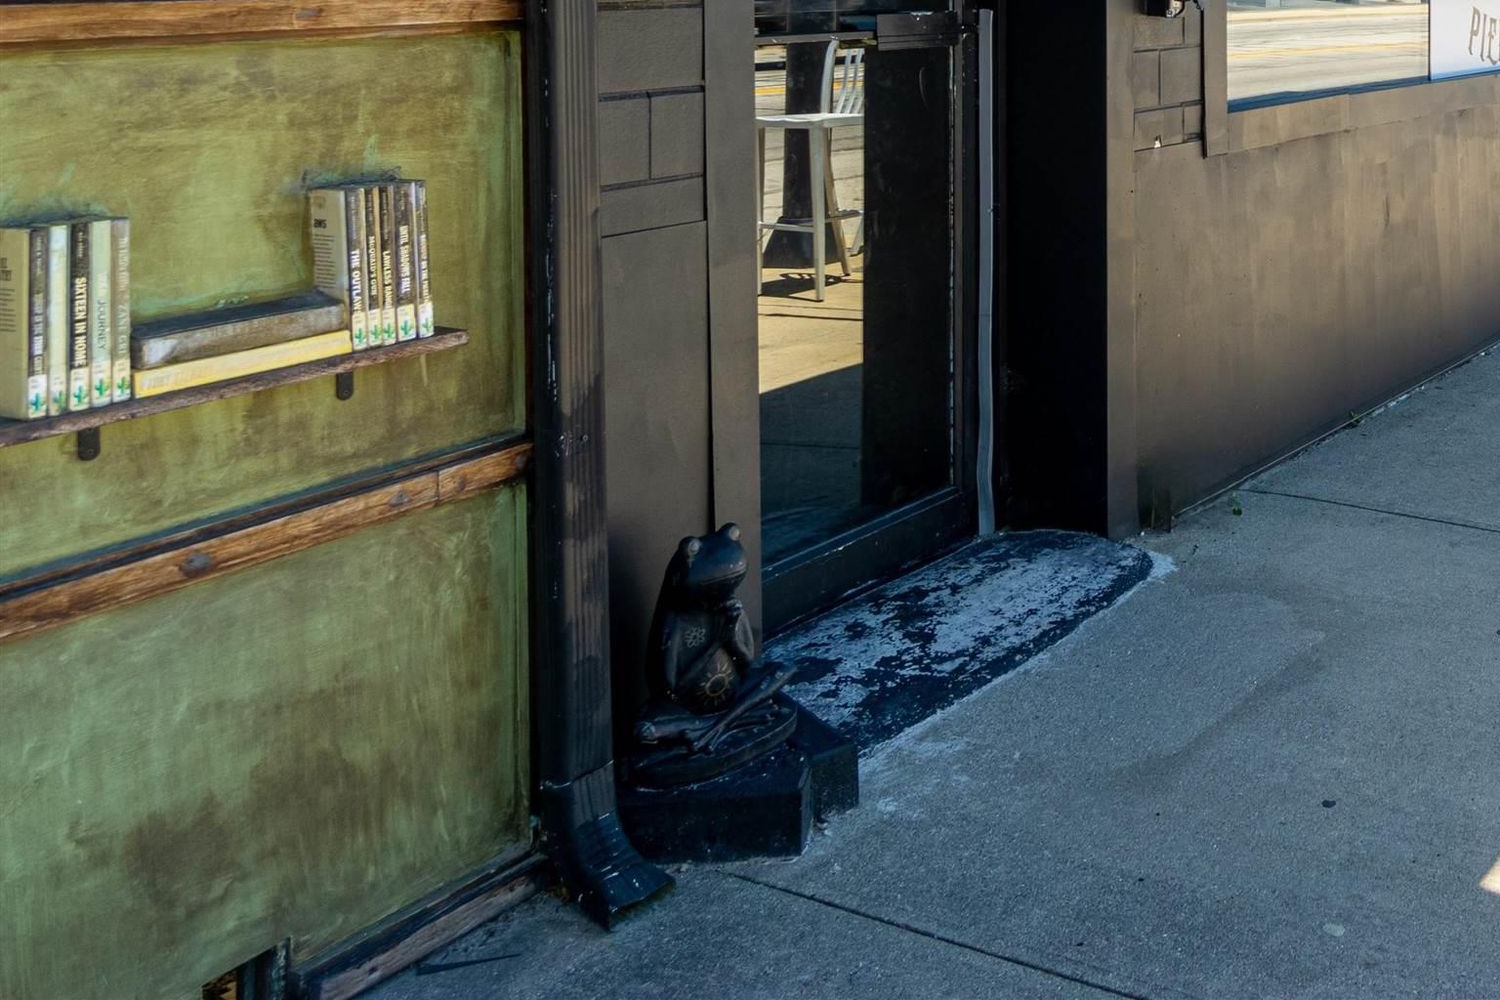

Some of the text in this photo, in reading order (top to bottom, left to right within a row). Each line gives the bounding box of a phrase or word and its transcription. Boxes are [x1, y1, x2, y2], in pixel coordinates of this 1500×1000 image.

[400, 225, 408, 244] UNTIL
[351, 249, 360, 268] THE
[383, 251, 391, 284] LAWLESS
[401, 277, 410, 293] FALL
[75, 277, 86, 366] SIXTEEN IN NOME
[97, 299, 106, 350] JOURNEY
